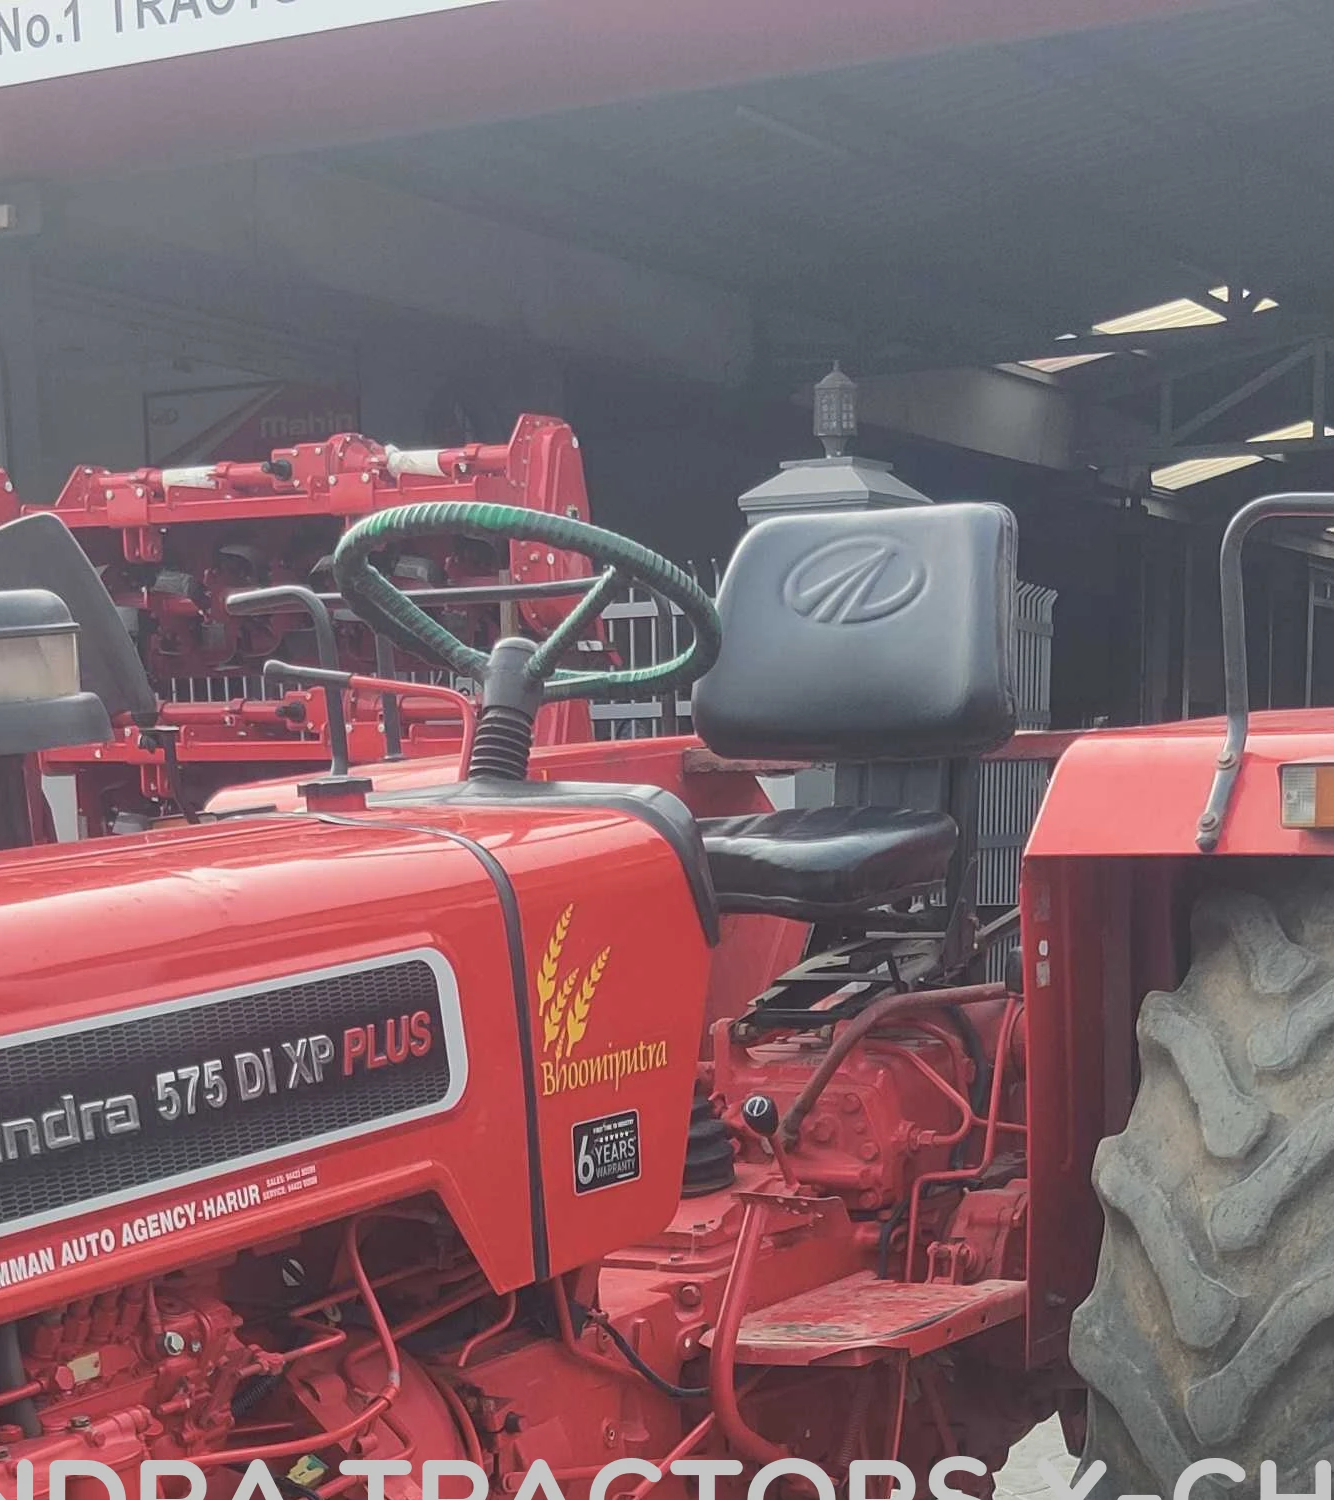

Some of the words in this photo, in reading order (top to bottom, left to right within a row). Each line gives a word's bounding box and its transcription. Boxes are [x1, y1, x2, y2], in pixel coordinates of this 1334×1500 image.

[155, 1060, 229, 1121] 575
[234, 1047, 277, 1101] DI
[281, 1034, 335, 1089] XP
[343, 1010, 433, 1076] PLUS
[540, 1039, 668, 1097] Bhoomiputra
[578, 1135, 594, 1185] 6
[61, 1228, 116, 1268] AUTO
[121, 1183, 261, 1248] AGENCY-HARUR
